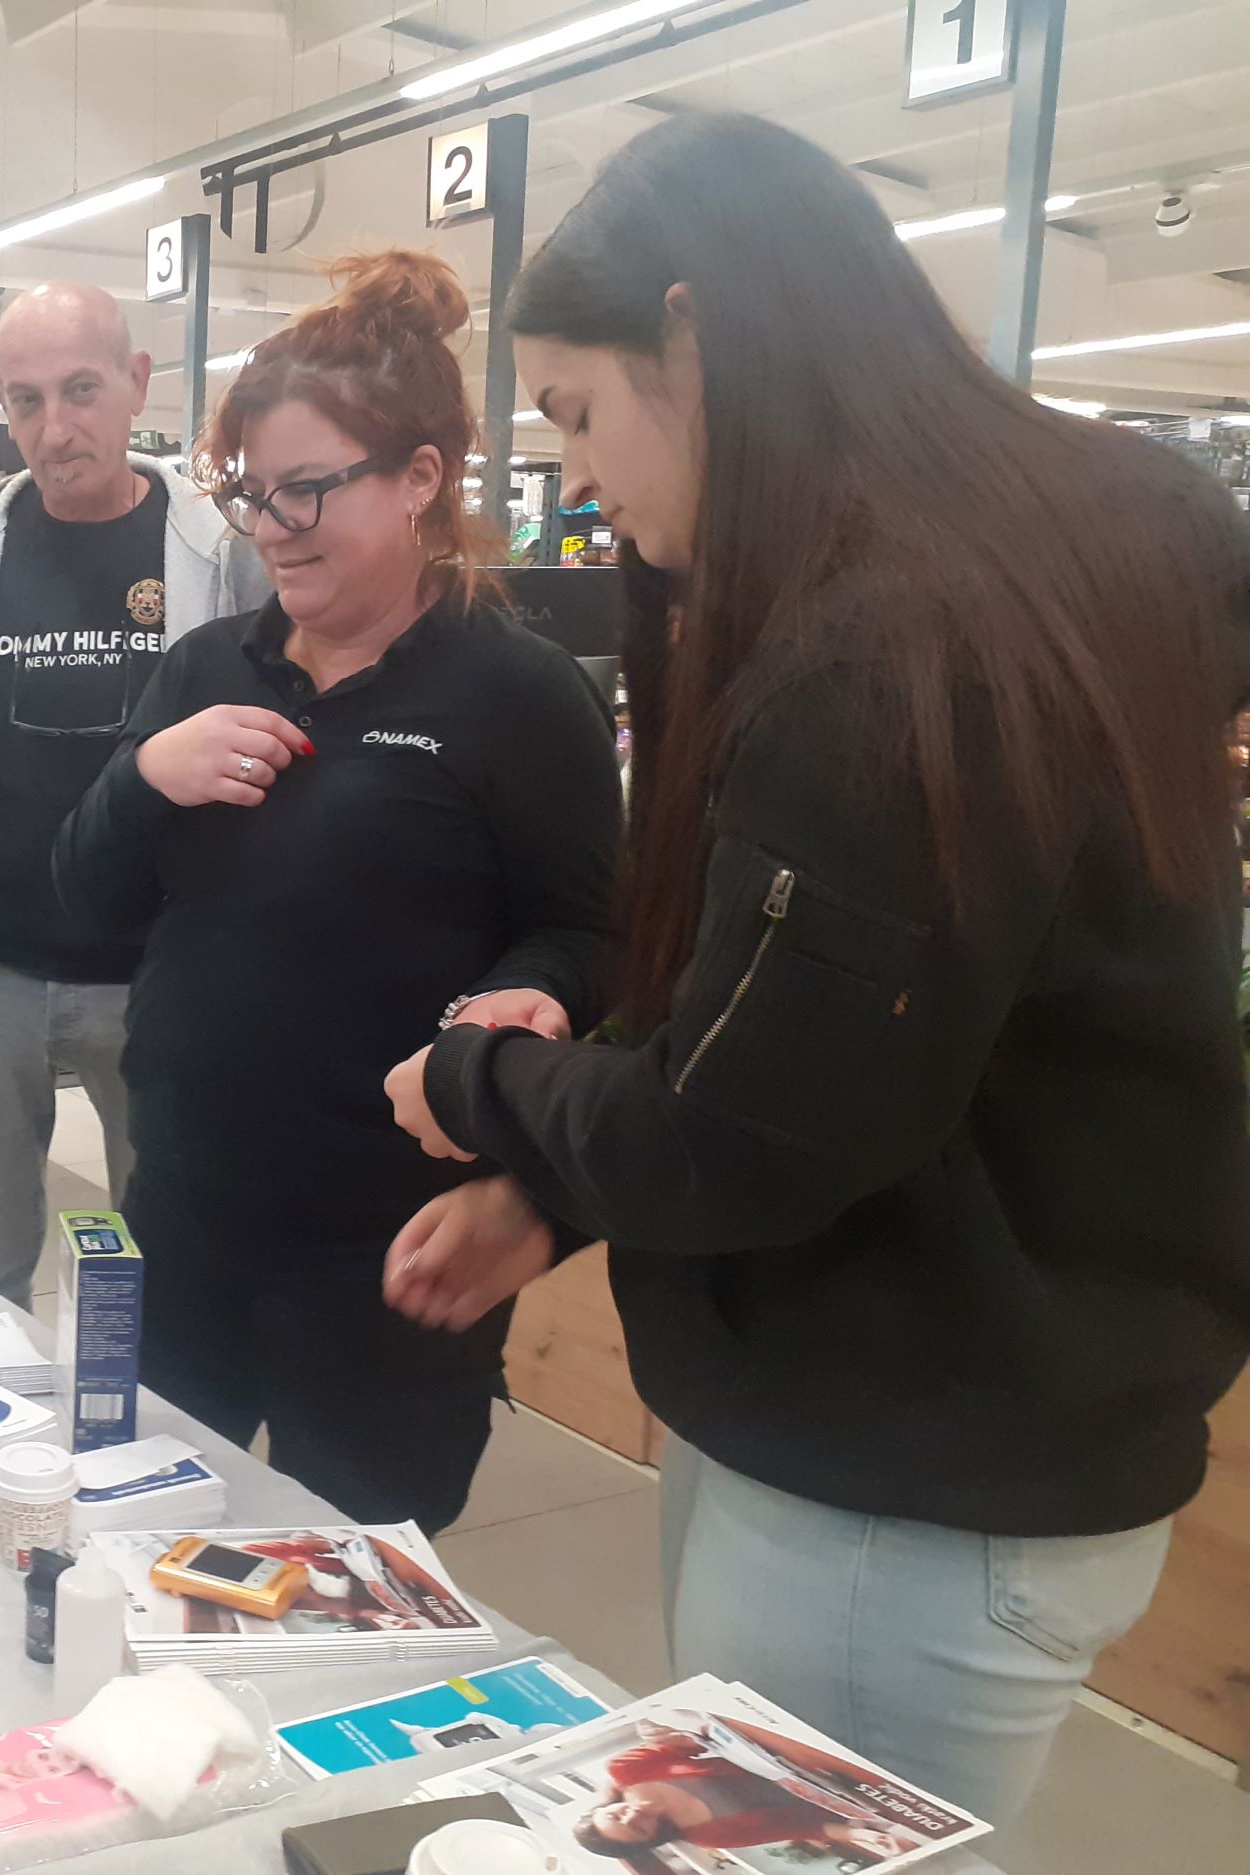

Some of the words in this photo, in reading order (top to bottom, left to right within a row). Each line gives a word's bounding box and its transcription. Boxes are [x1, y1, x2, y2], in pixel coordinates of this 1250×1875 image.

[942, 0, 975, 65] 1
[443, 145, 474, 204] 2
[157, 236, 173, 283] 3
[25, 655, 56, 669] NEW
[103, 652, 123, 665] NY
